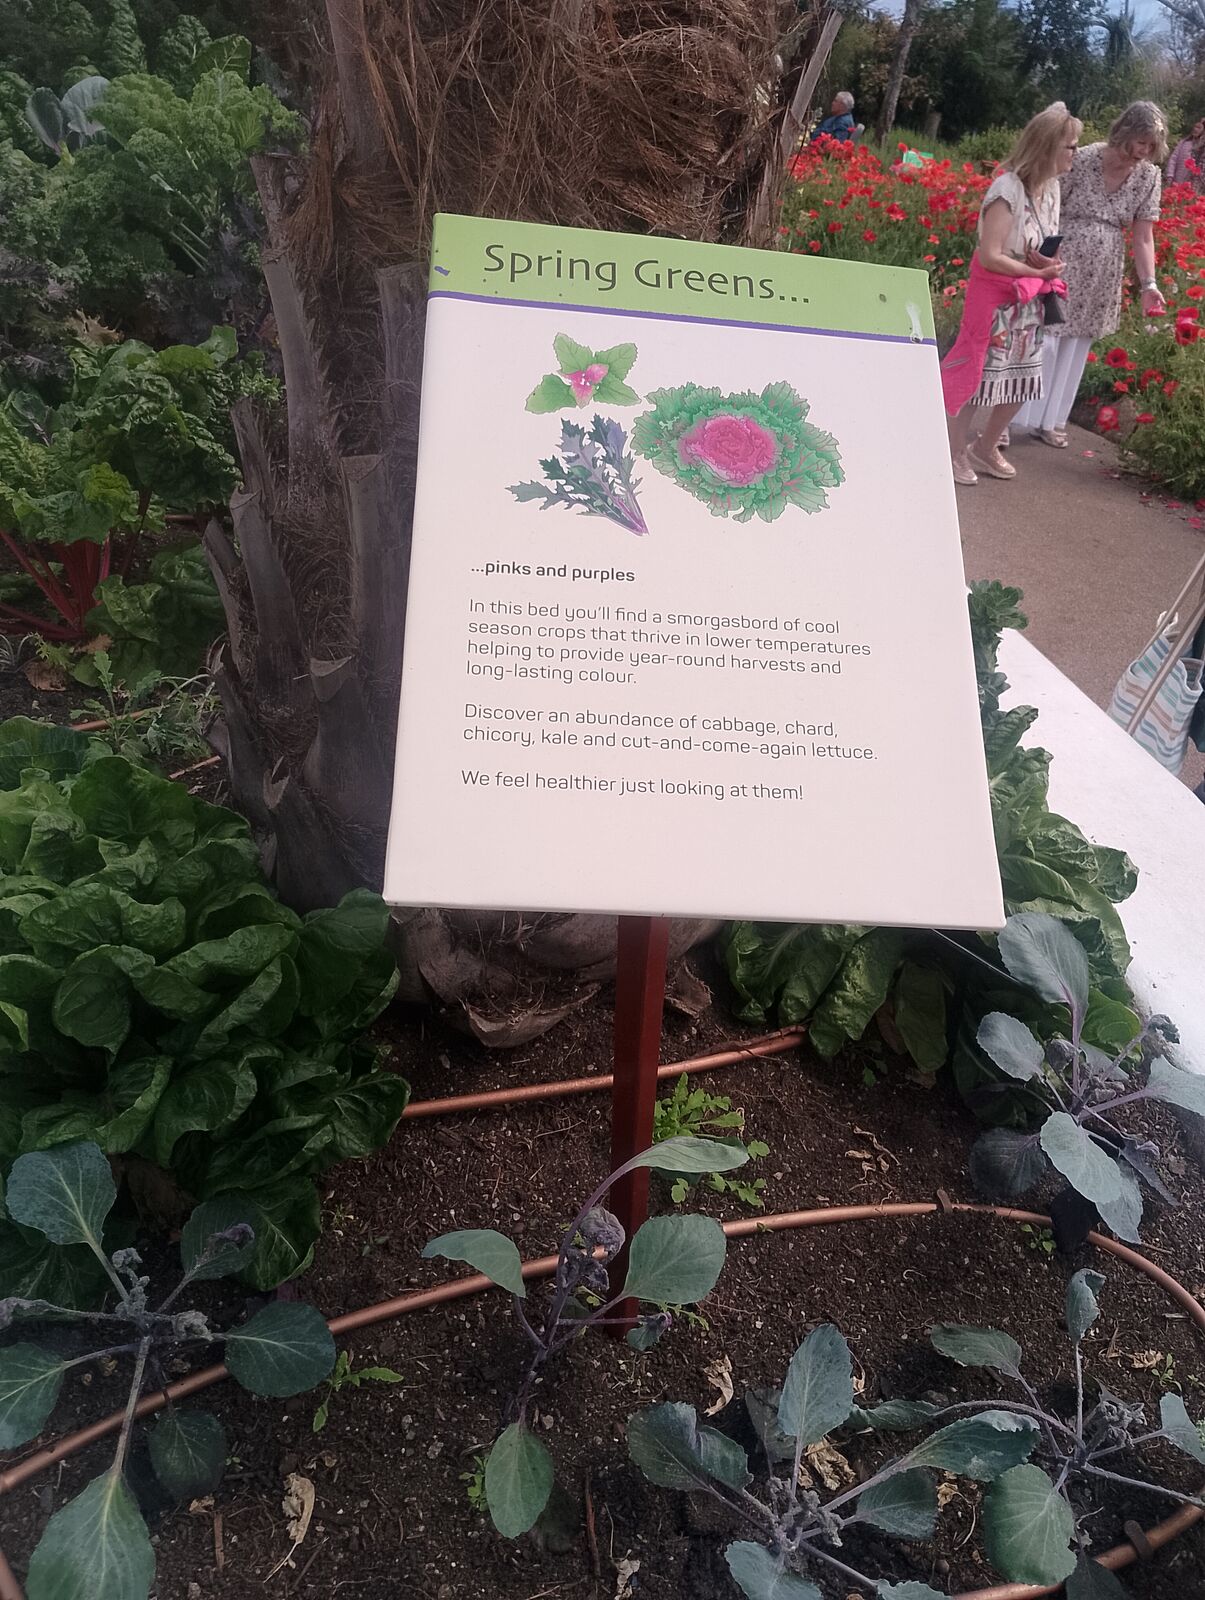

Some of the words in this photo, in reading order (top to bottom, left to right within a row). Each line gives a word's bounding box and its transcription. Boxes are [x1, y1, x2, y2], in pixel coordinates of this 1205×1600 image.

[483, 245, 616, 291] Spring
[536, 565, 566, 577] and
[573, 568, 634, 583] purples
[470, 599, 484, 612] In
[490, 600, 522, 615] this
[529, 602, 558, 617] bed
[616, 608, 646, 622] find
[653, 613, 661, 623] a
[668, 614, 777, 630] smorgasbord
[784, 619, 800, 631] of
[805, 621, 839, 633] cool
[469, 623, 531, 635] season
[538, 627, 585, 641] crops
[591, 627, 626, 641] that
[631, 629, 680, 644] thrive
[687, 632, 699, 645] in
[706, 633, 751, 648] lower
[755, 638, 870, 655] temperatures
[467, 661, 572, 683] long-lasting
[579, 668, 636, 683] colour.
[468, 641, 531, 660] helping
[537, 646, 554, 658] to
[561, 648, 623, 662] provide
[630, 653, 725, 667] year-round
[731, 655, 805, 672] harvests
[811, 661, 840, 674] and
[466, 704, 543, 721] Discover
[549, 712, 569, 722] an
[576, 710, 673, 727] abundance
[680, 715, 697, 728] of
[702, 717, 779, 736] cabbage,
[786, 721, 837, 738] chard,
[464, 726, 534, 747] chicory,
[542, 729, 577, 745] kale
[584, 733, 615, 746] and
[622, 735, 806, 758] cut-and-come-again
[812, 743, 877, 759] lettuce.
[462, 770, 489, 785] We
[495, 772, 528, 787] feel
[536, 773, 616, 791] healthier
[619, 778, 655, 795] just
[661, 779, 724, 800] looking
[731, 785, 747, 797] at
[752, 784, 802, 800] them!
